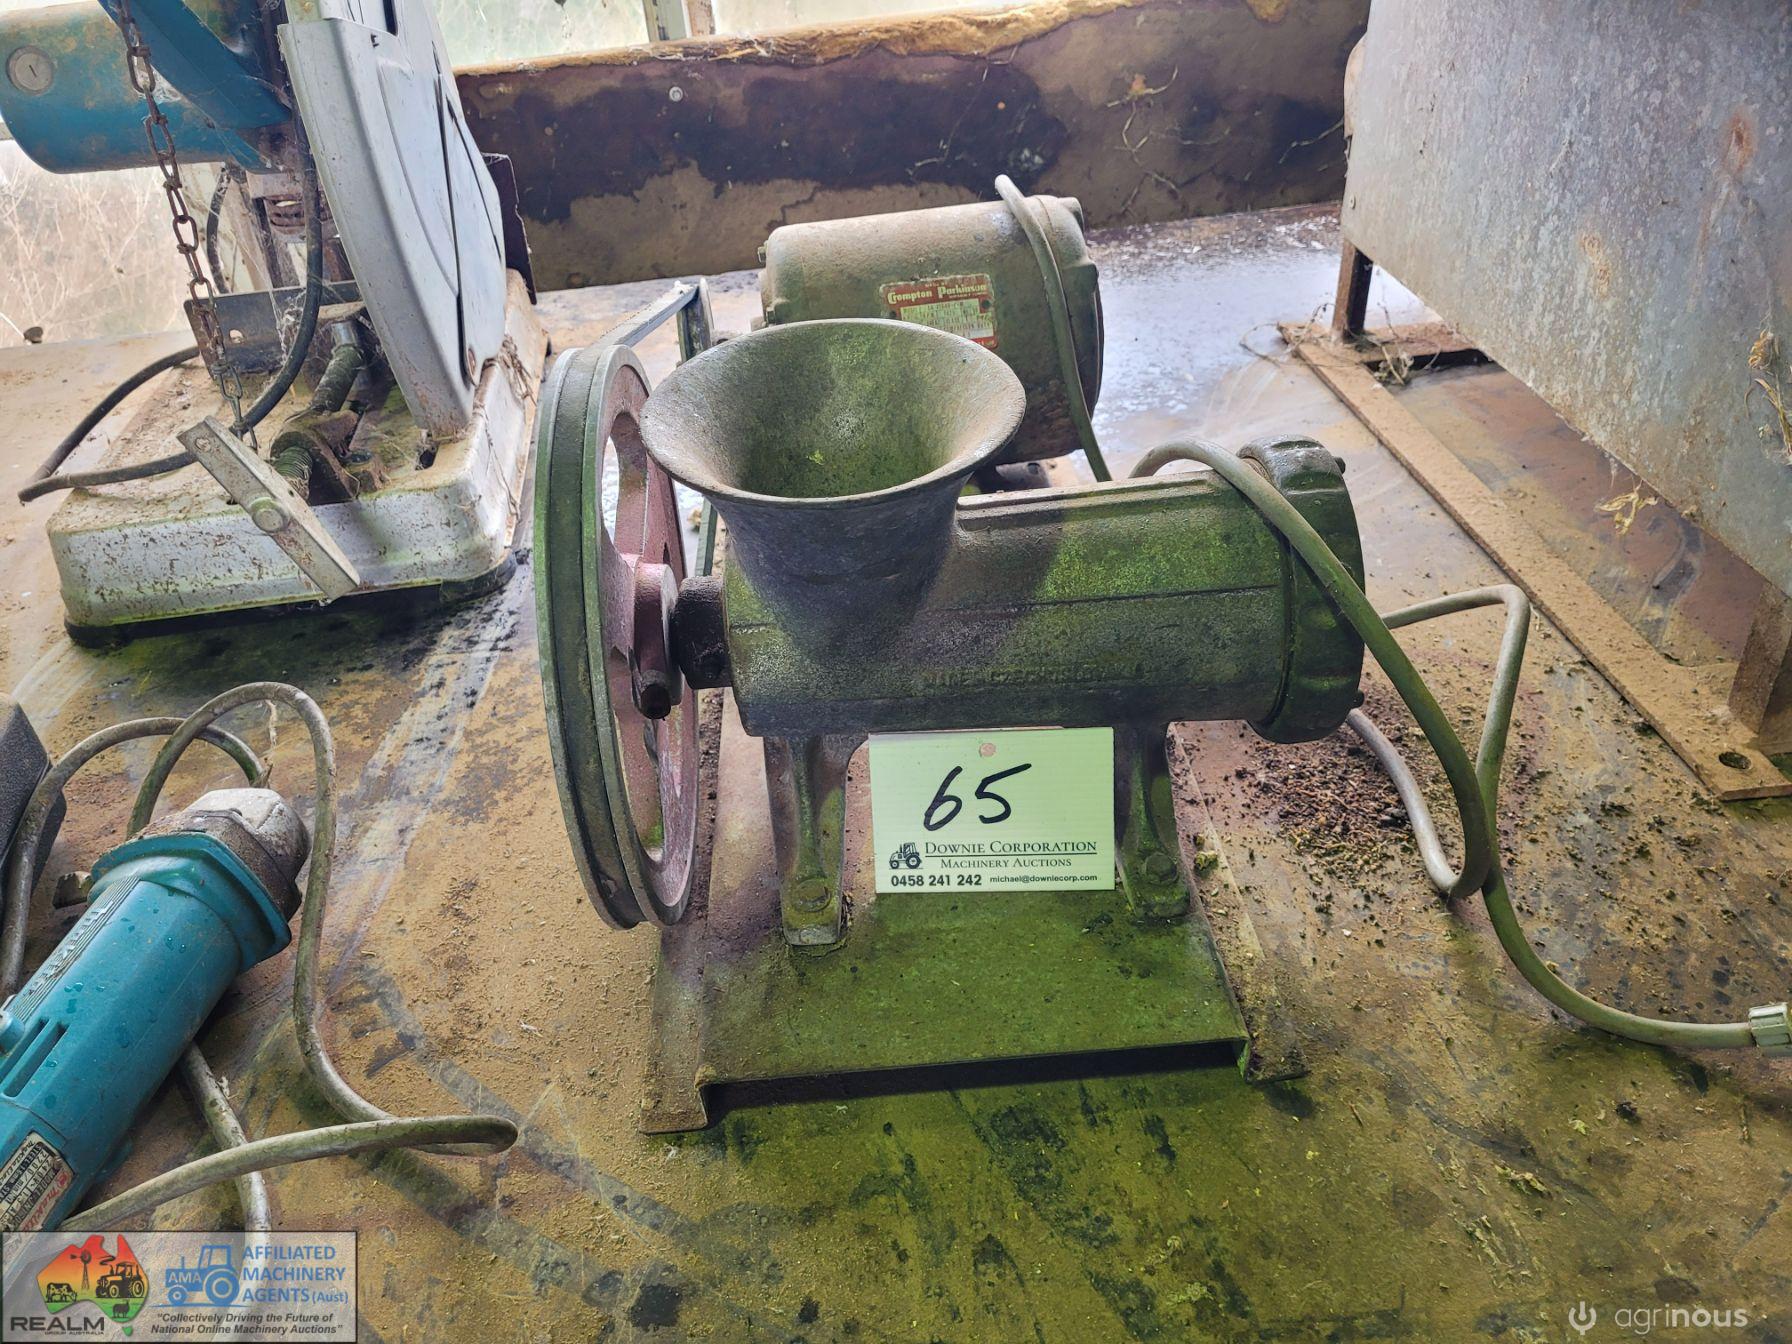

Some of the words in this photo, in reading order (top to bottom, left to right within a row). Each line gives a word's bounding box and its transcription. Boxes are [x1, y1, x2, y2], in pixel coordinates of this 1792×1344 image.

[887, 289, 933, 305] Crompton
[937, 283, 987, 299] Parkinson
[923, 763, 1032, 831] 65
[925, 841, 985, 854] DOWNIE
[989, 840, 1097, 854] CORPORATION
[940, 858, 1010, 868] MACHINERY
[1012, 858, 1072, 868] AUCTIONS
[891, 874, 924, 887] 0458
[928, 874, 951, 886] 241
[957, 874, 982, 886] 242
[989, 874, 1098, 883] michael@downiecorp.com
